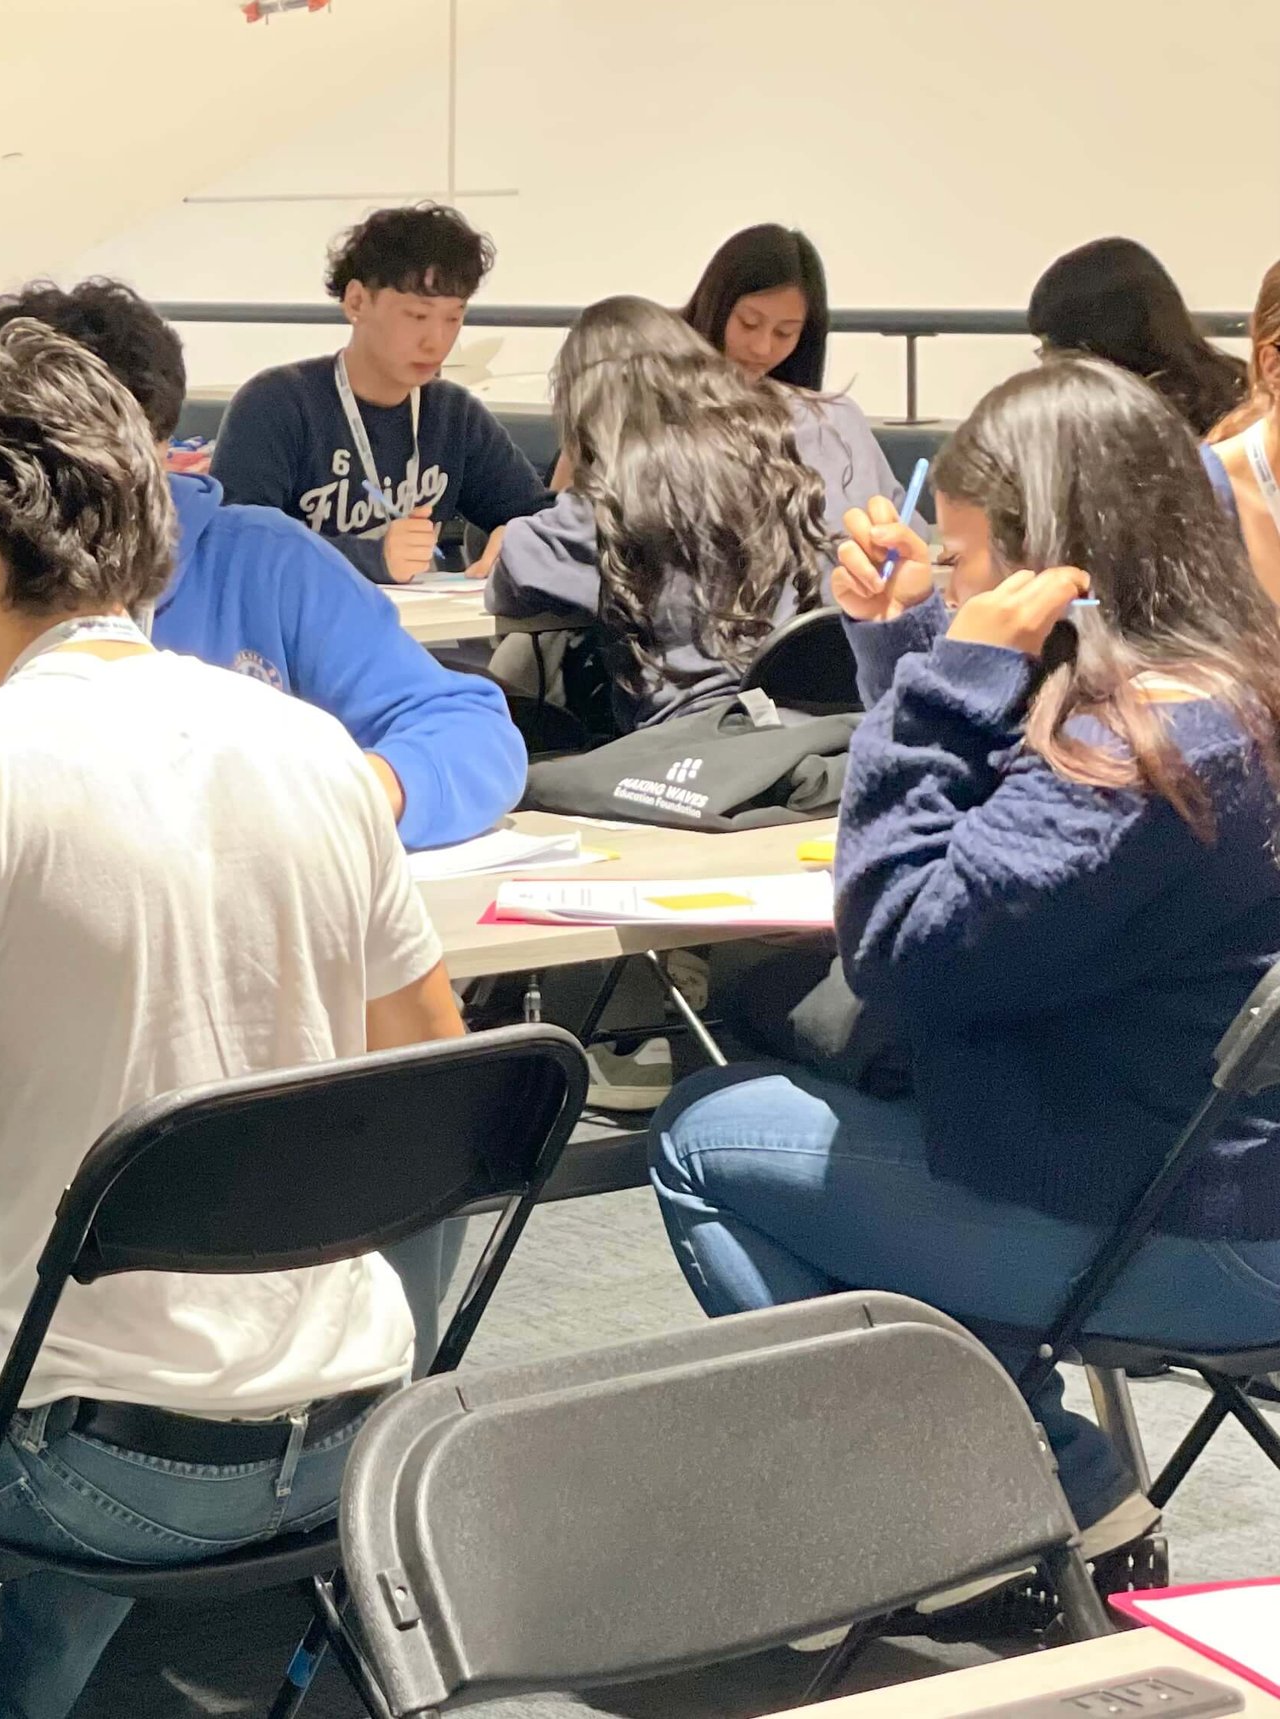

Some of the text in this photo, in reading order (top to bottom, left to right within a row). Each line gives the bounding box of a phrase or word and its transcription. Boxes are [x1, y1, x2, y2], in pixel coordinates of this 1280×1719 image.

[332, 448, 351, 476] 6
[618, 777, 709, 808] MAKING WAVES
